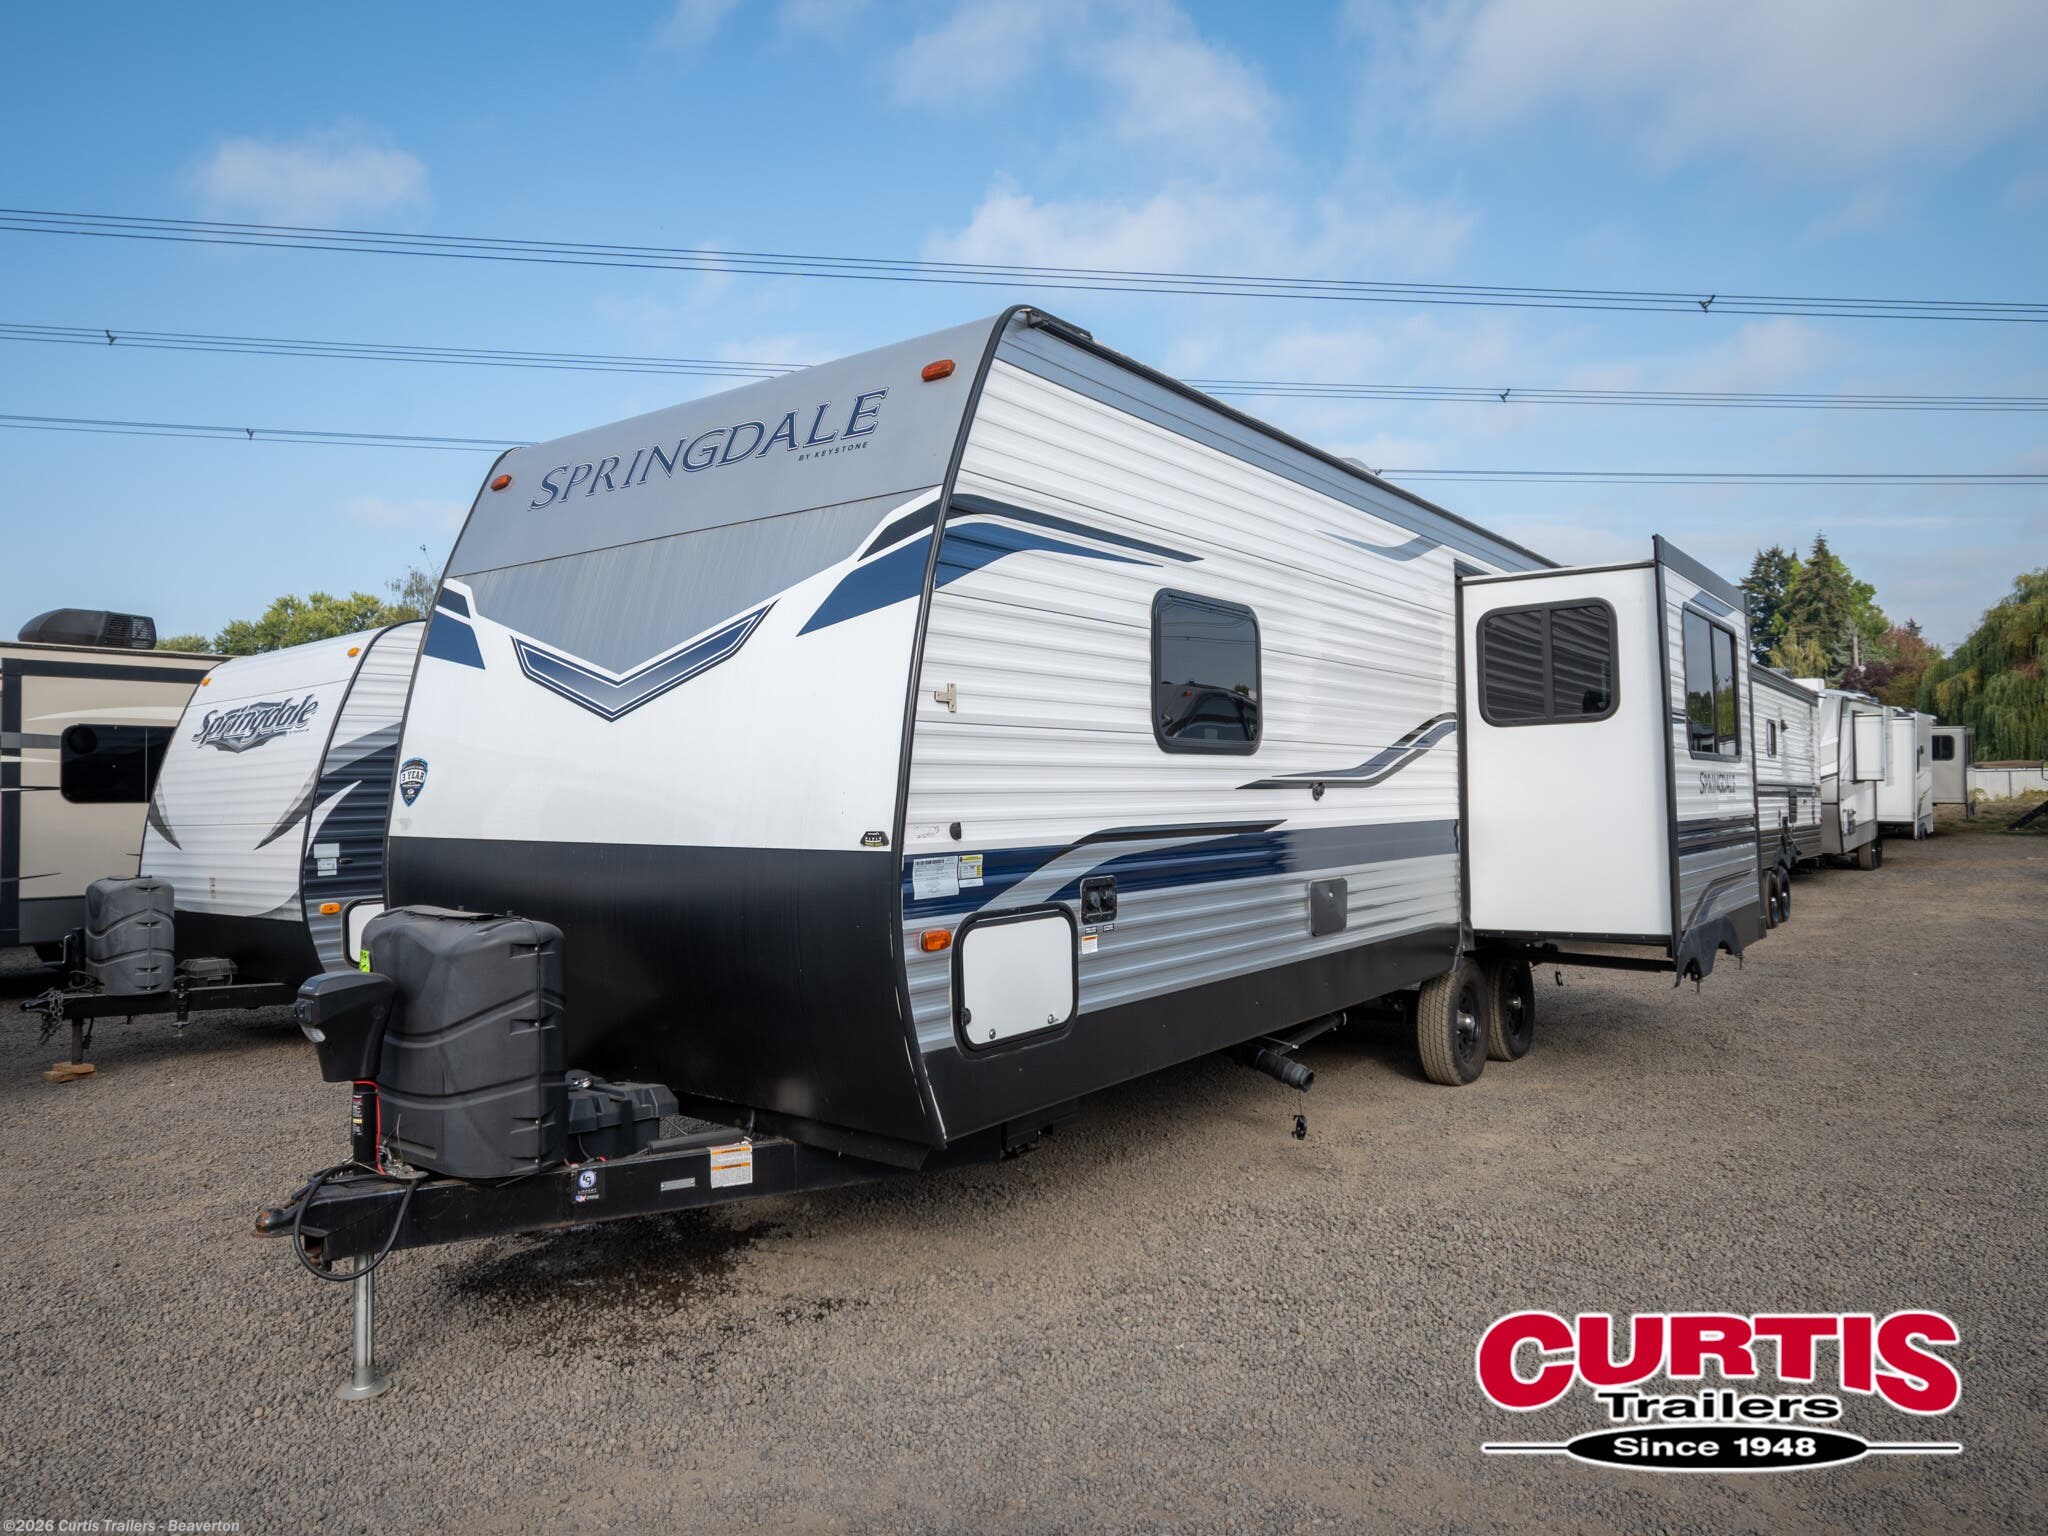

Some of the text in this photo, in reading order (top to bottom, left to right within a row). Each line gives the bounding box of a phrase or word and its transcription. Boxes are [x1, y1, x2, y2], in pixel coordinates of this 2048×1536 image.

[528, 387, 891, 511] SPRINGDALE
[798, 441, 869, 461] BY KEYSTONE
[192, 693, 319, 749] Springdale
[407, 770, 425, 781] YEAR
